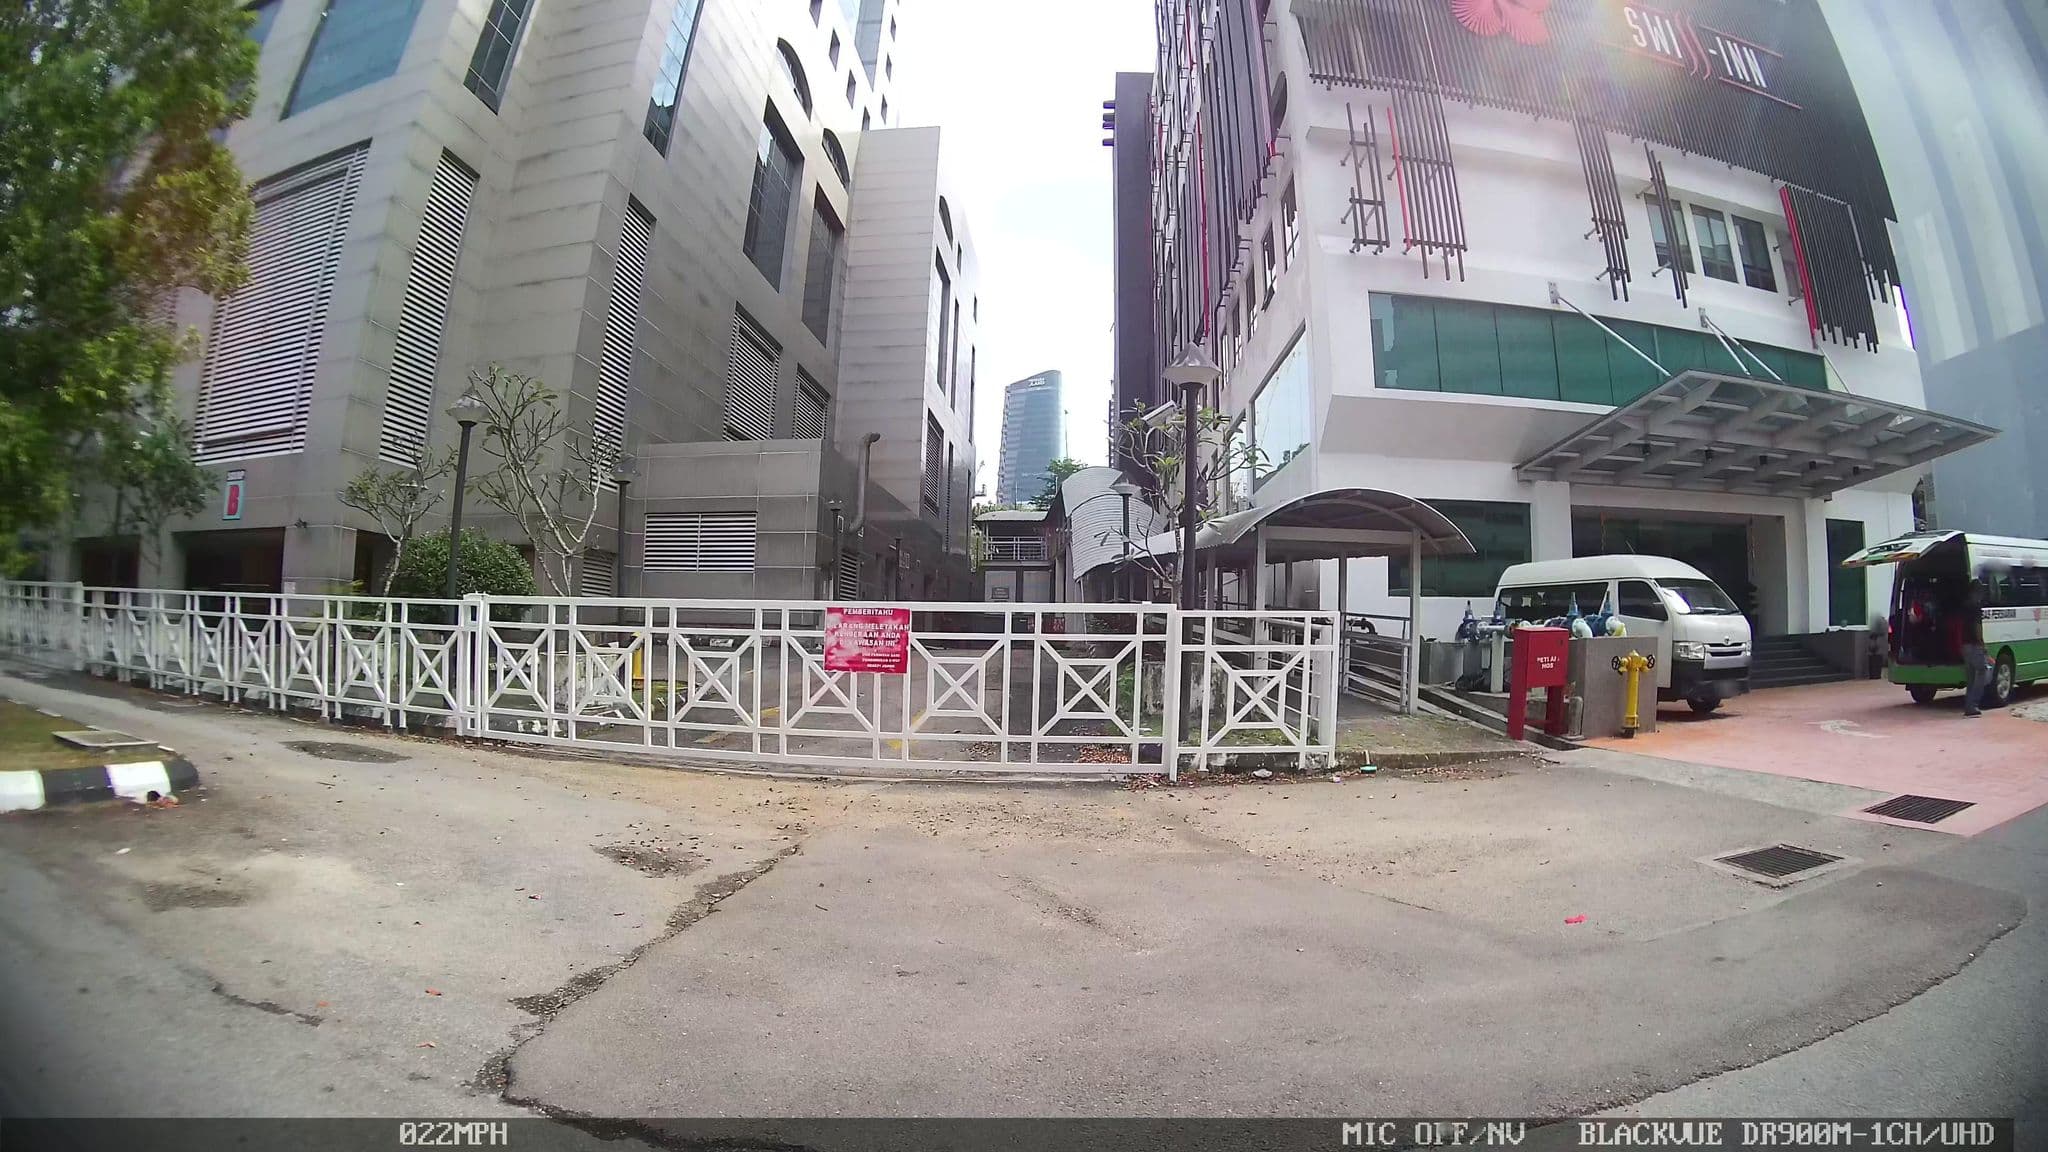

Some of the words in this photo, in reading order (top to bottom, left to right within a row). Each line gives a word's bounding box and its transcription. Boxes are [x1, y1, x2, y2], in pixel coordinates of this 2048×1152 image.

[1624, 7, 1767, 88] SWISS-INN
[227, 485, 240, 516] B
[849, 639, 884, 647] AWASAN
